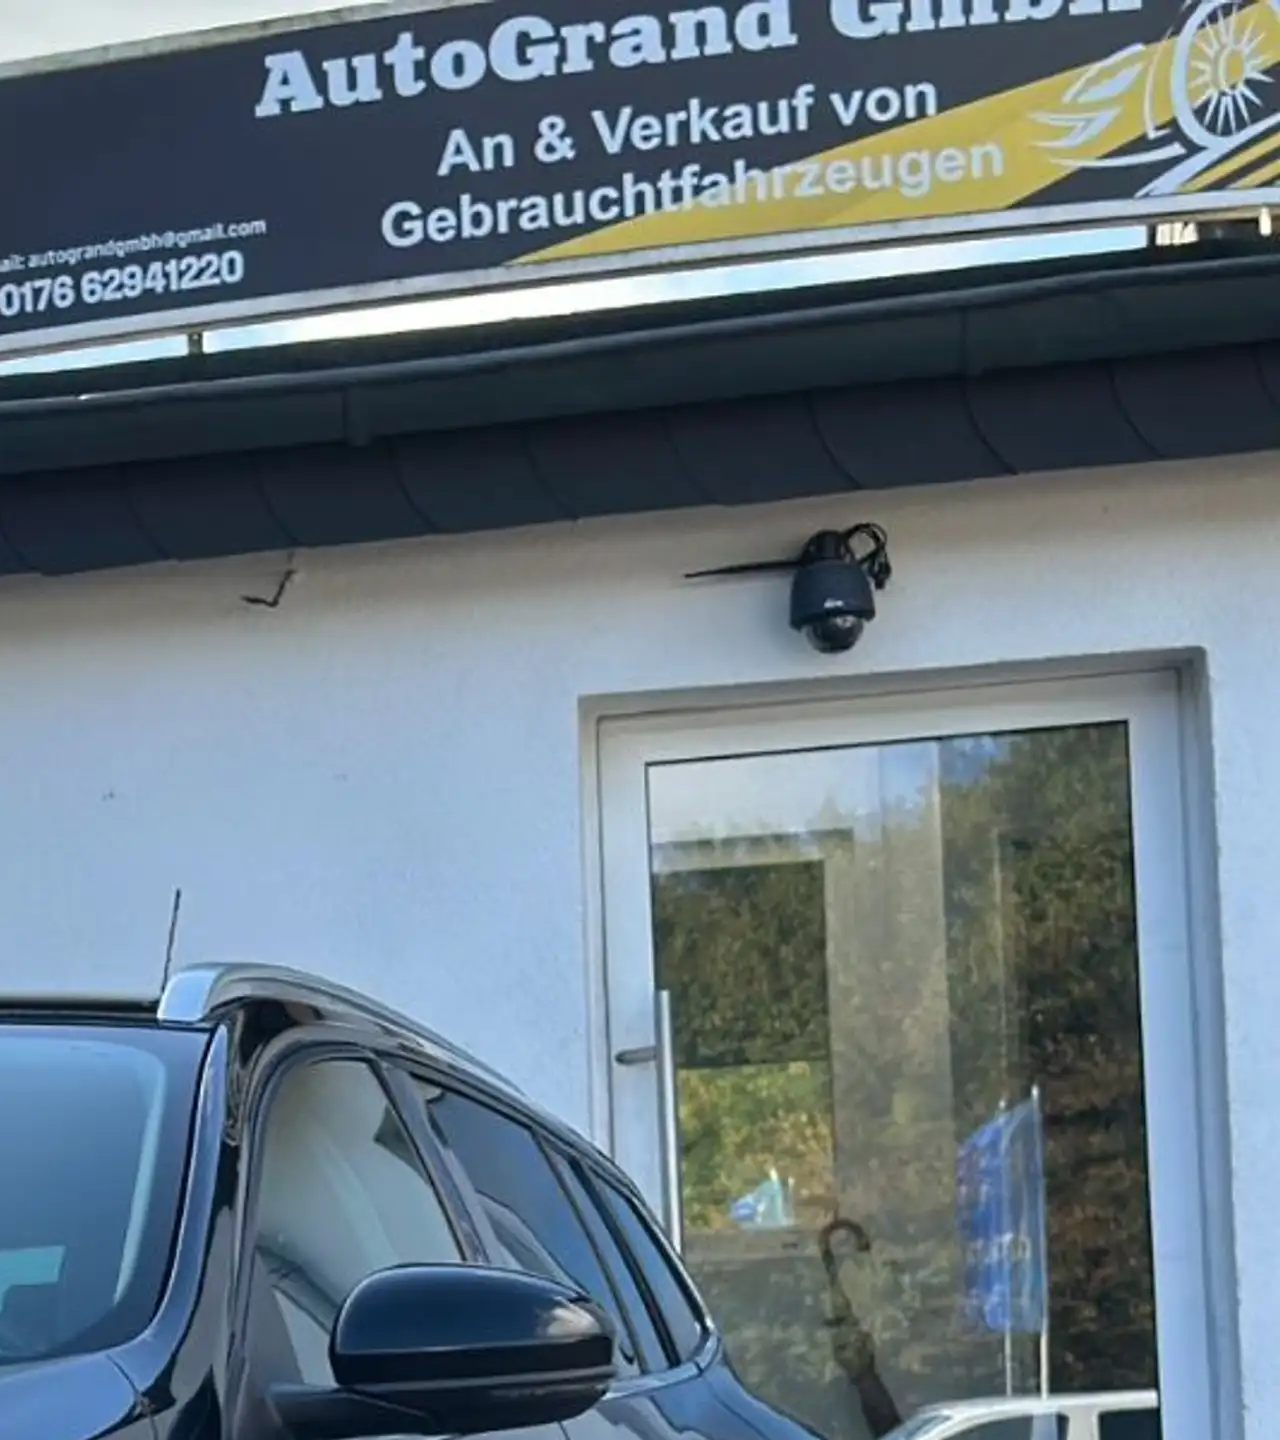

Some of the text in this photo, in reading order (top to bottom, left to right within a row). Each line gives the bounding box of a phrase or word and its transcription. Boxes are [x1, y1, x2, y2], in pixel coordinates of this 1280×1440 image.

[255, 0, 1142, 118] AutoGrand Gm
[437, 81, 938, 176] An & Verkauf von
[381, 140, 1004, 248] Gebrauchtfahrzeugen
[28, 219, 267, 269] autograndgmbh@gmail.com
[80, 250, 244, 304] 62941220
